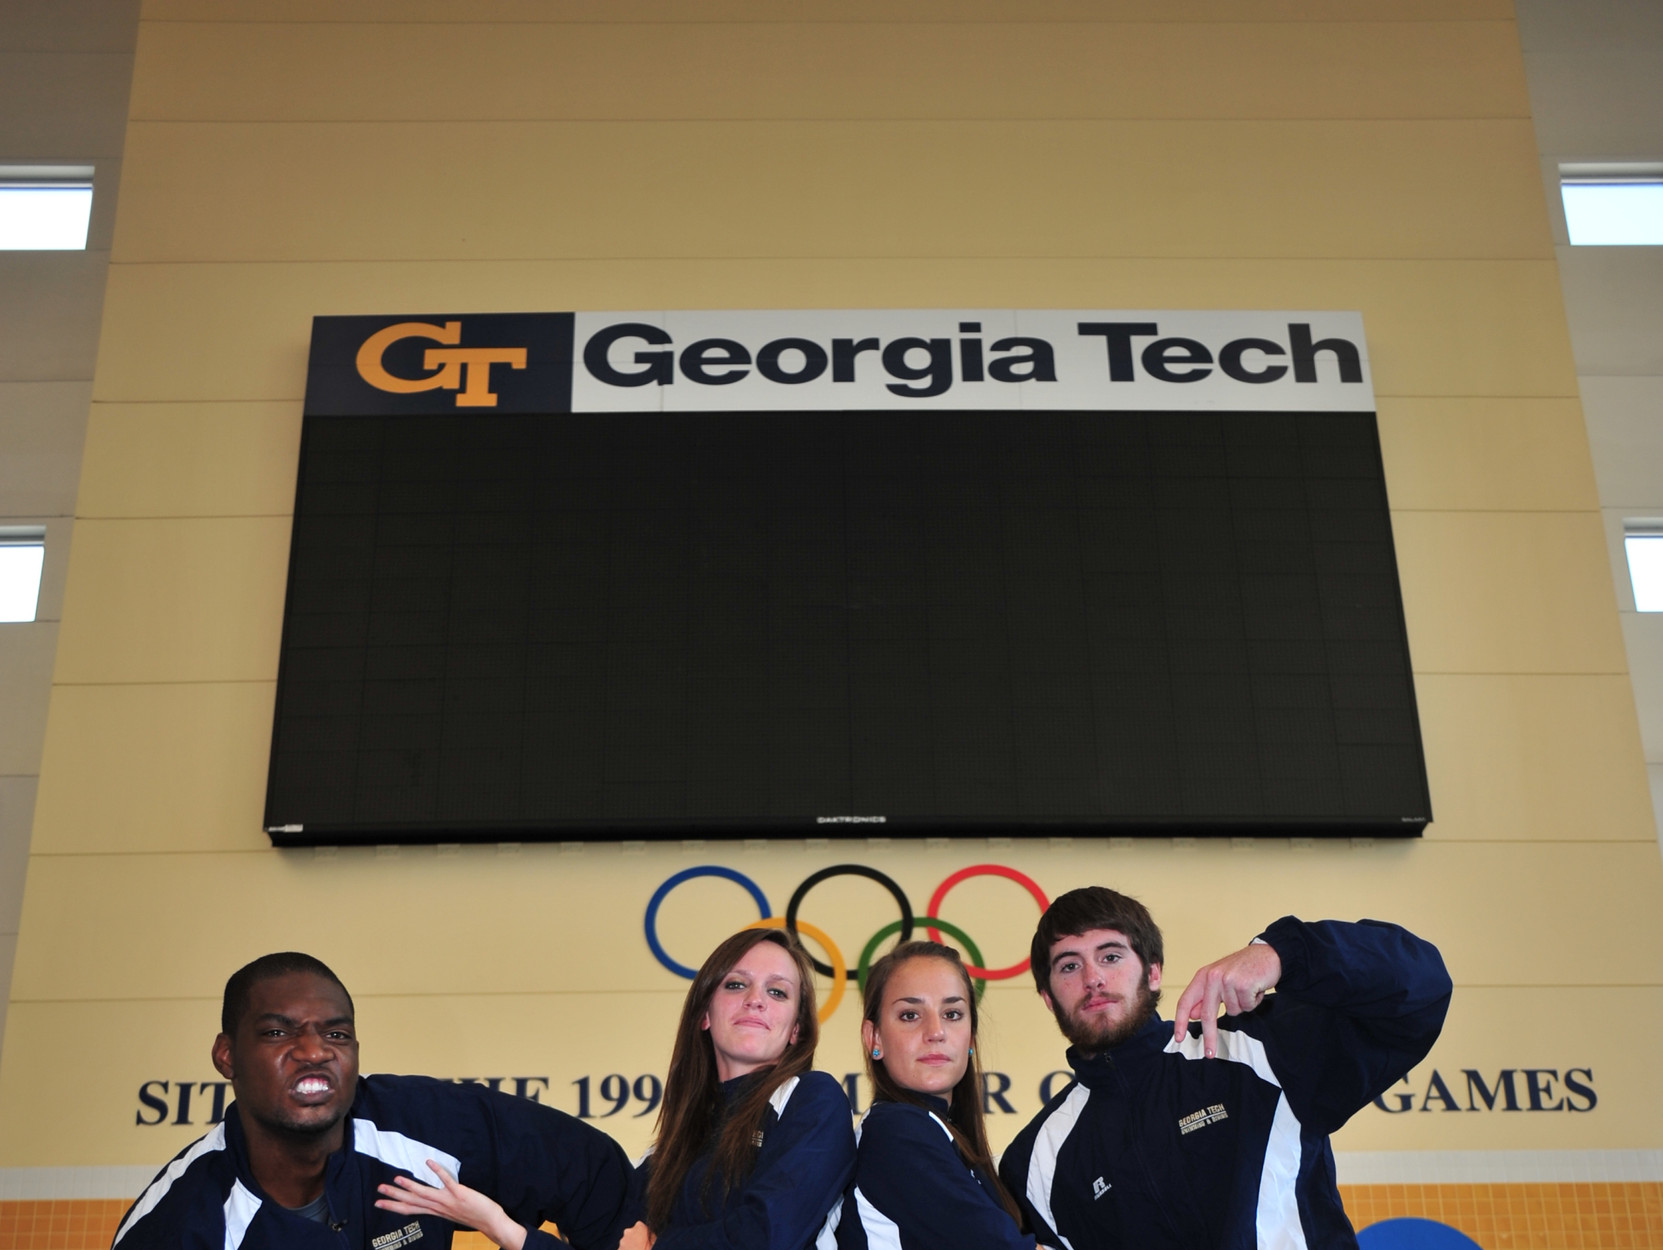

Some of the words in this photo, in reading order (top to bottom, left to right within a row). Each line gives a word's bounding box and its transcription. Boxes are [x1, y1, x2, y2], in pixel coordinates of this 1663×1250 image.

[355, 320, 528, 407] GT
[582, 321, 1058, 398] Georgia
[1076, 321, 1364, 384] Tech
[135, 1079, 234, 1126] SIT
[571, 1073, 663, 1119] 199
[1372, 1067, 1598, 1114] GAMES
[1178, 1108, 1207, 1128] GEORGIA
[1206, 1103, 1225, 1115] TECH
[371, 1229, 403, 1248] GEORGIA
[403, 1220, 420, 1235] TECH
